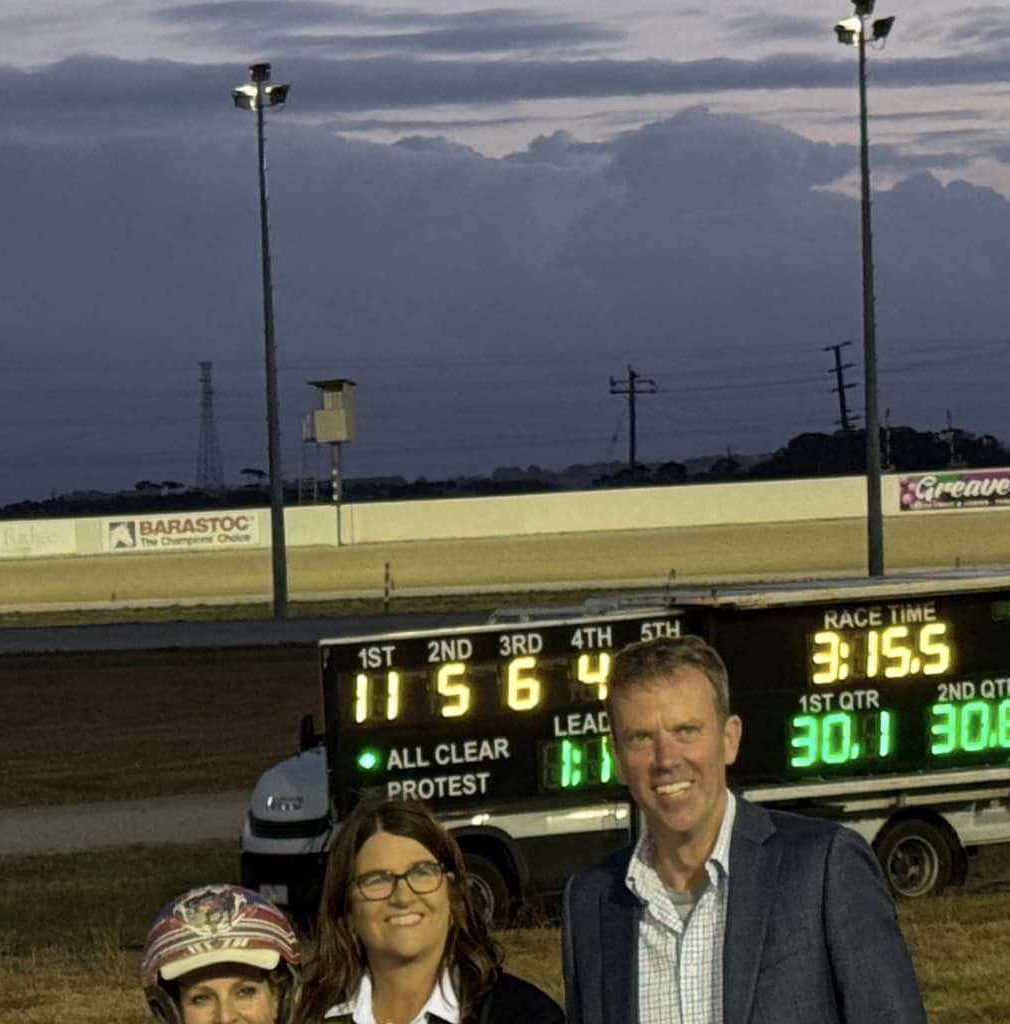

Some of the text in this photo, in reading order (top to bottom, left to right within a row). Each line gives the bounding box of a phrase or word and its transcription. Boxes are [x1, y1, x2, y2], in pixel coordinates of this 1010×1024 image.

[140, 516, 249, 536] BARASTOC
[142, 537, 157, 546] The
[824, 602, 937, 629] RACE TIME
[358, 620, 681, 669] 1ST 2ND 3RD 4TH 5TH
[813, 623, 950, 684] 3:15.5
[355, 652, 610, 724] 11 5 6 4
[799, 690, 879, 713] 1ST QTR
[937, 683, 975, 702] 2ND
[791, 711, 890, 768] 30.1
[387, 738, 510, 770] ALL CLEAR
[387, 773, 490, 800] PROTEST
